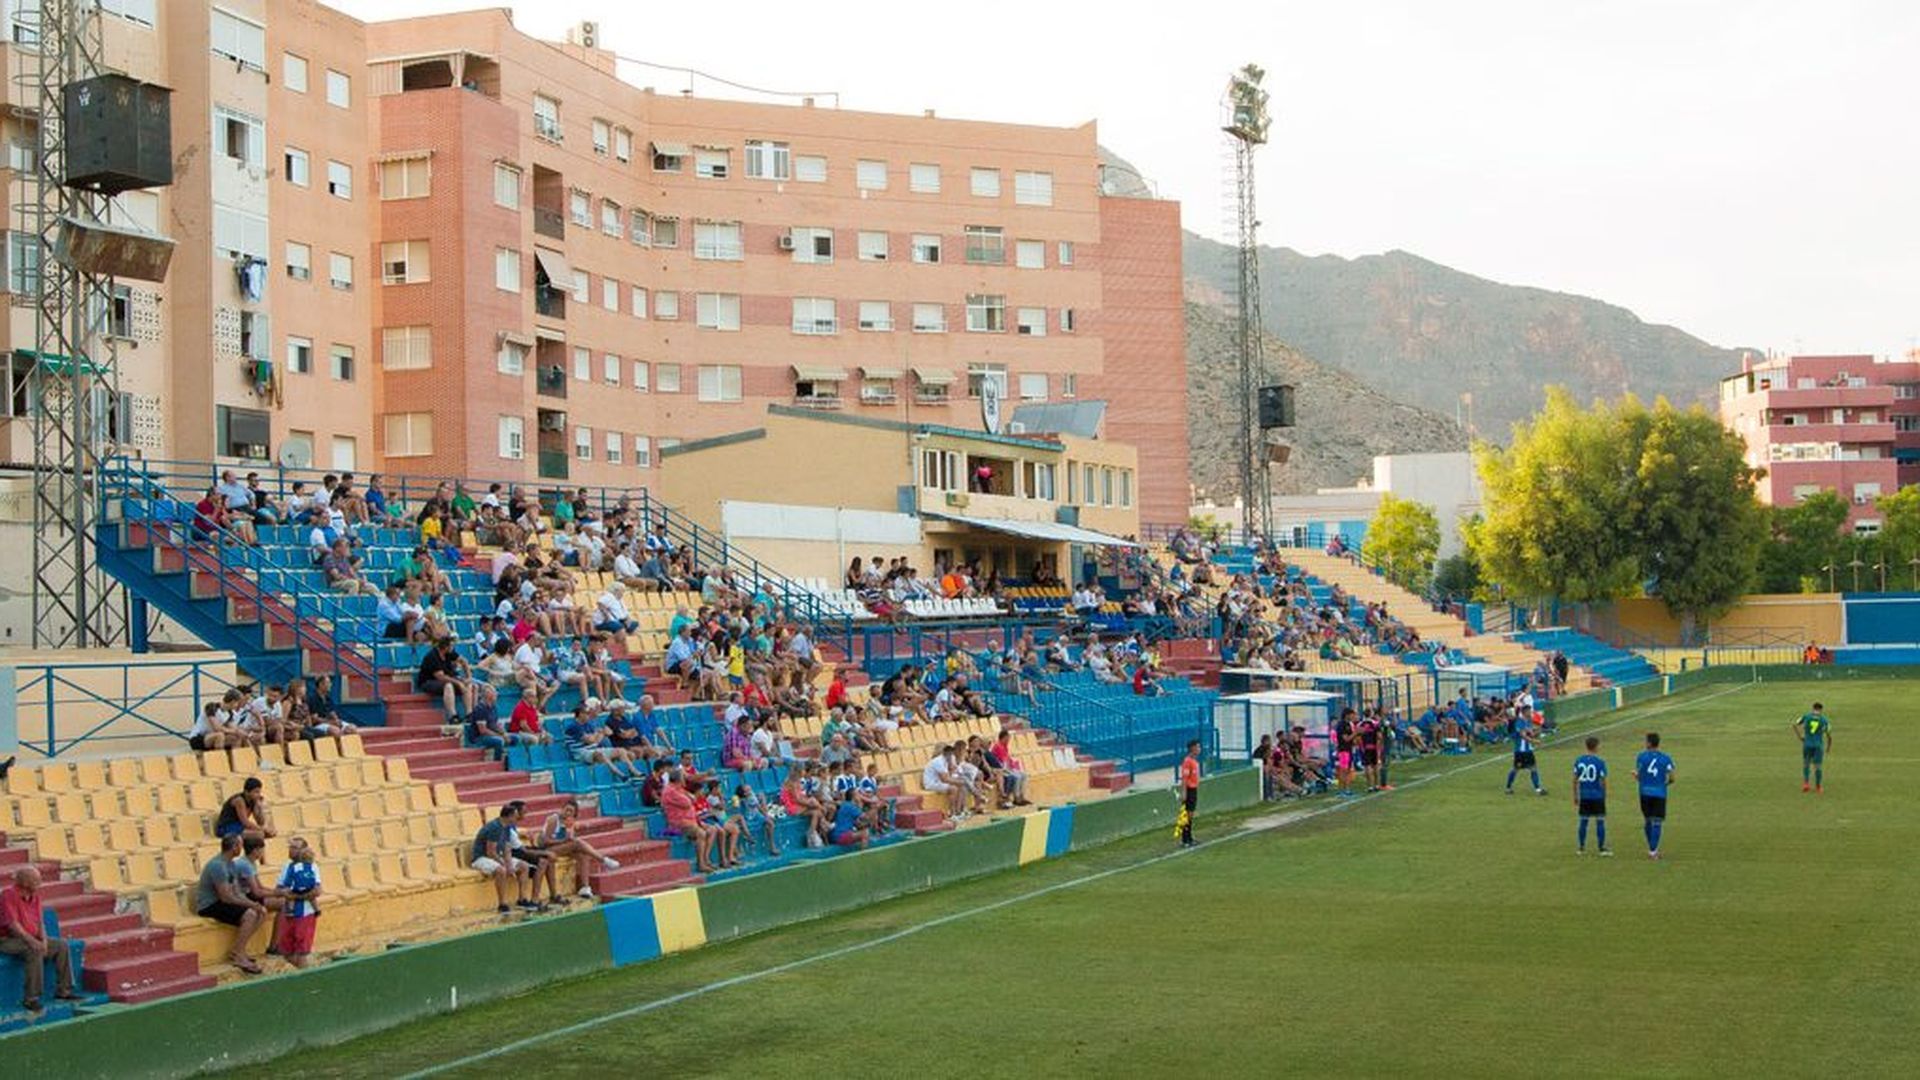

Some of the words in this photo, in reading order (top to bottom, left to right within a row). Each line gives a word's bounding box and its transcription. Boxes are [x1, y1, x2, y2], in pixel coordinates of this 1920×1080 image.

[1810, 720, 1819, 734] 7
[1578, 762, 1597, 782] 20
[1647, 758, 1658, 777] 4
